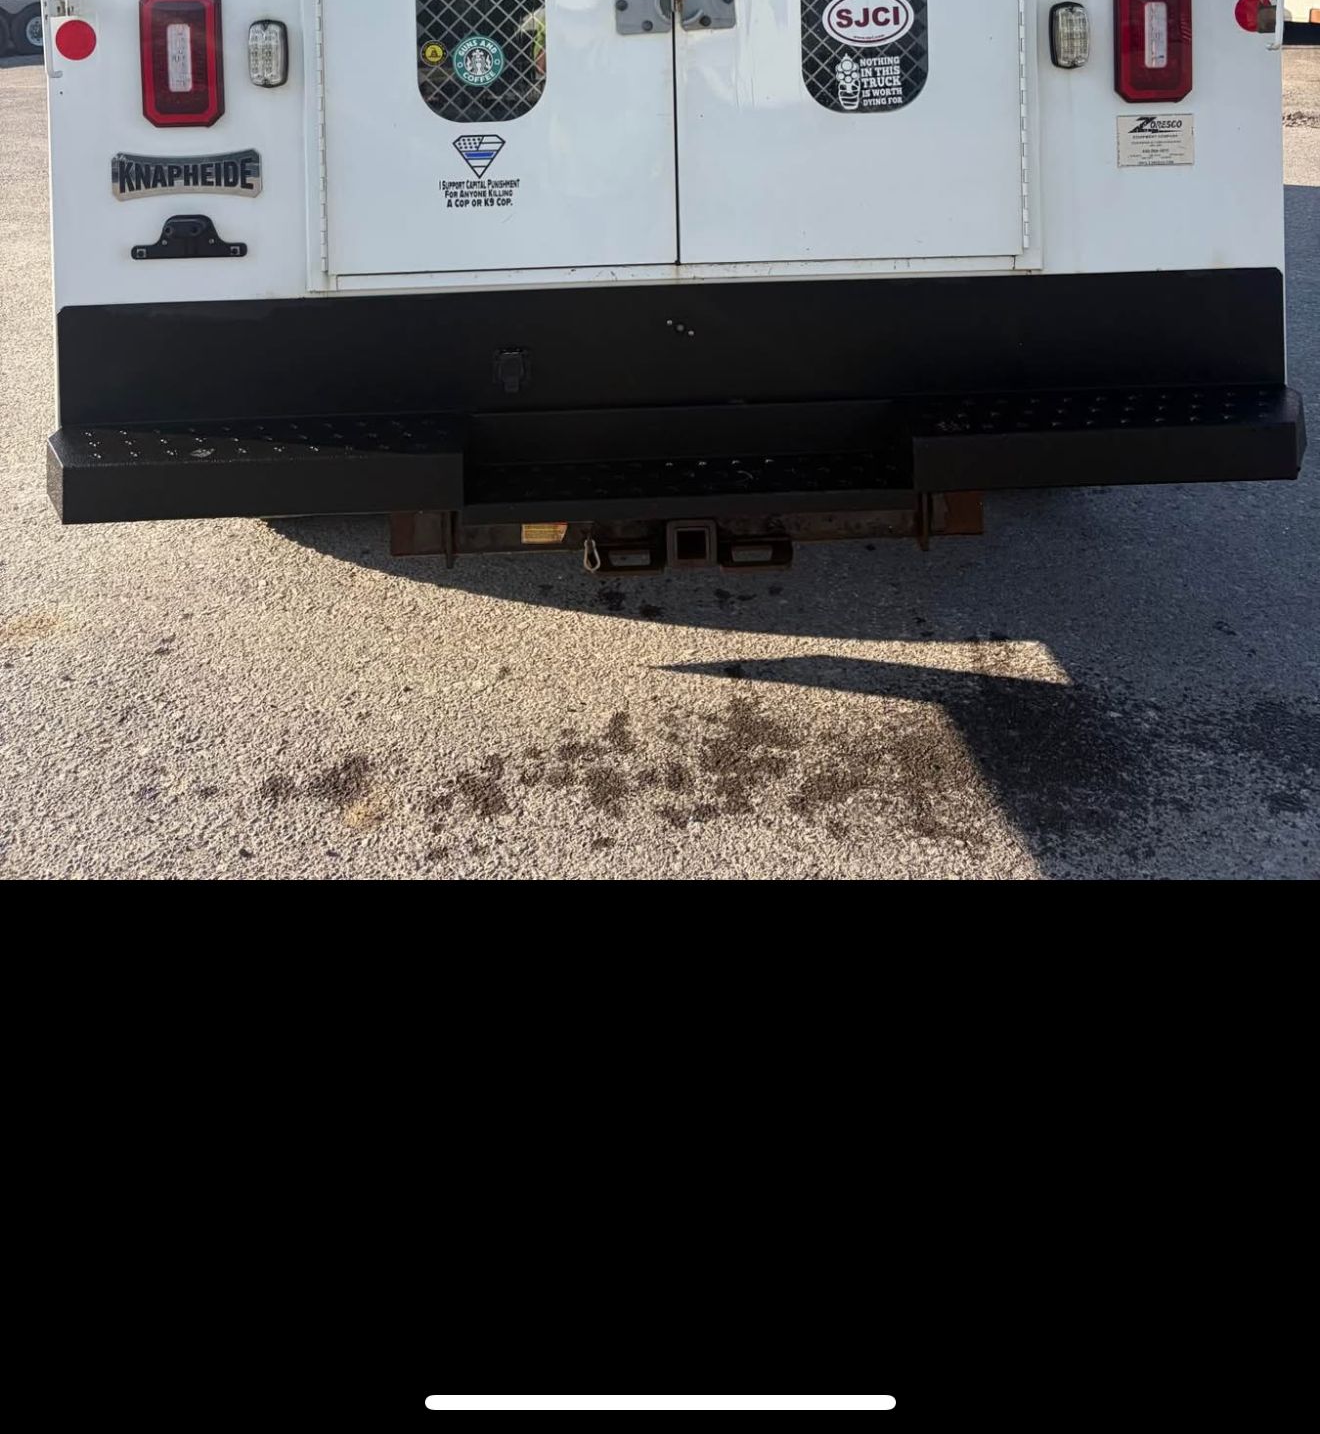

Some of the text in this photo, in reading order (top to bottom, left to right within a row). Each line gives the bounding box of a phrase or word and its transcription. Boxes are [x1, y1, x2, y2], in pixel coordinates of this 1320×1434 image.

[835, 6, 901, 29] SJCI
[458, 39, 478, 57] GUNS
[479, 40, 498, 54] AND
[859, 56, 900, 67] NOTHING
[462, 69, 497, 83] COFFEE
[860, 65, 901, 77] IN THIS
[861, 75, 902, 88] TRUCK
[862, 87, 903, 98] IS WORTH
[863, 96, 904, 106] DYING FOR
[1127, 116, 1183, 133] ZORESCO
[119, 156, 255, 193] KNAPHEIDE
[446, 199, 453, 208] A
[484, 197, 495, 207] K9
